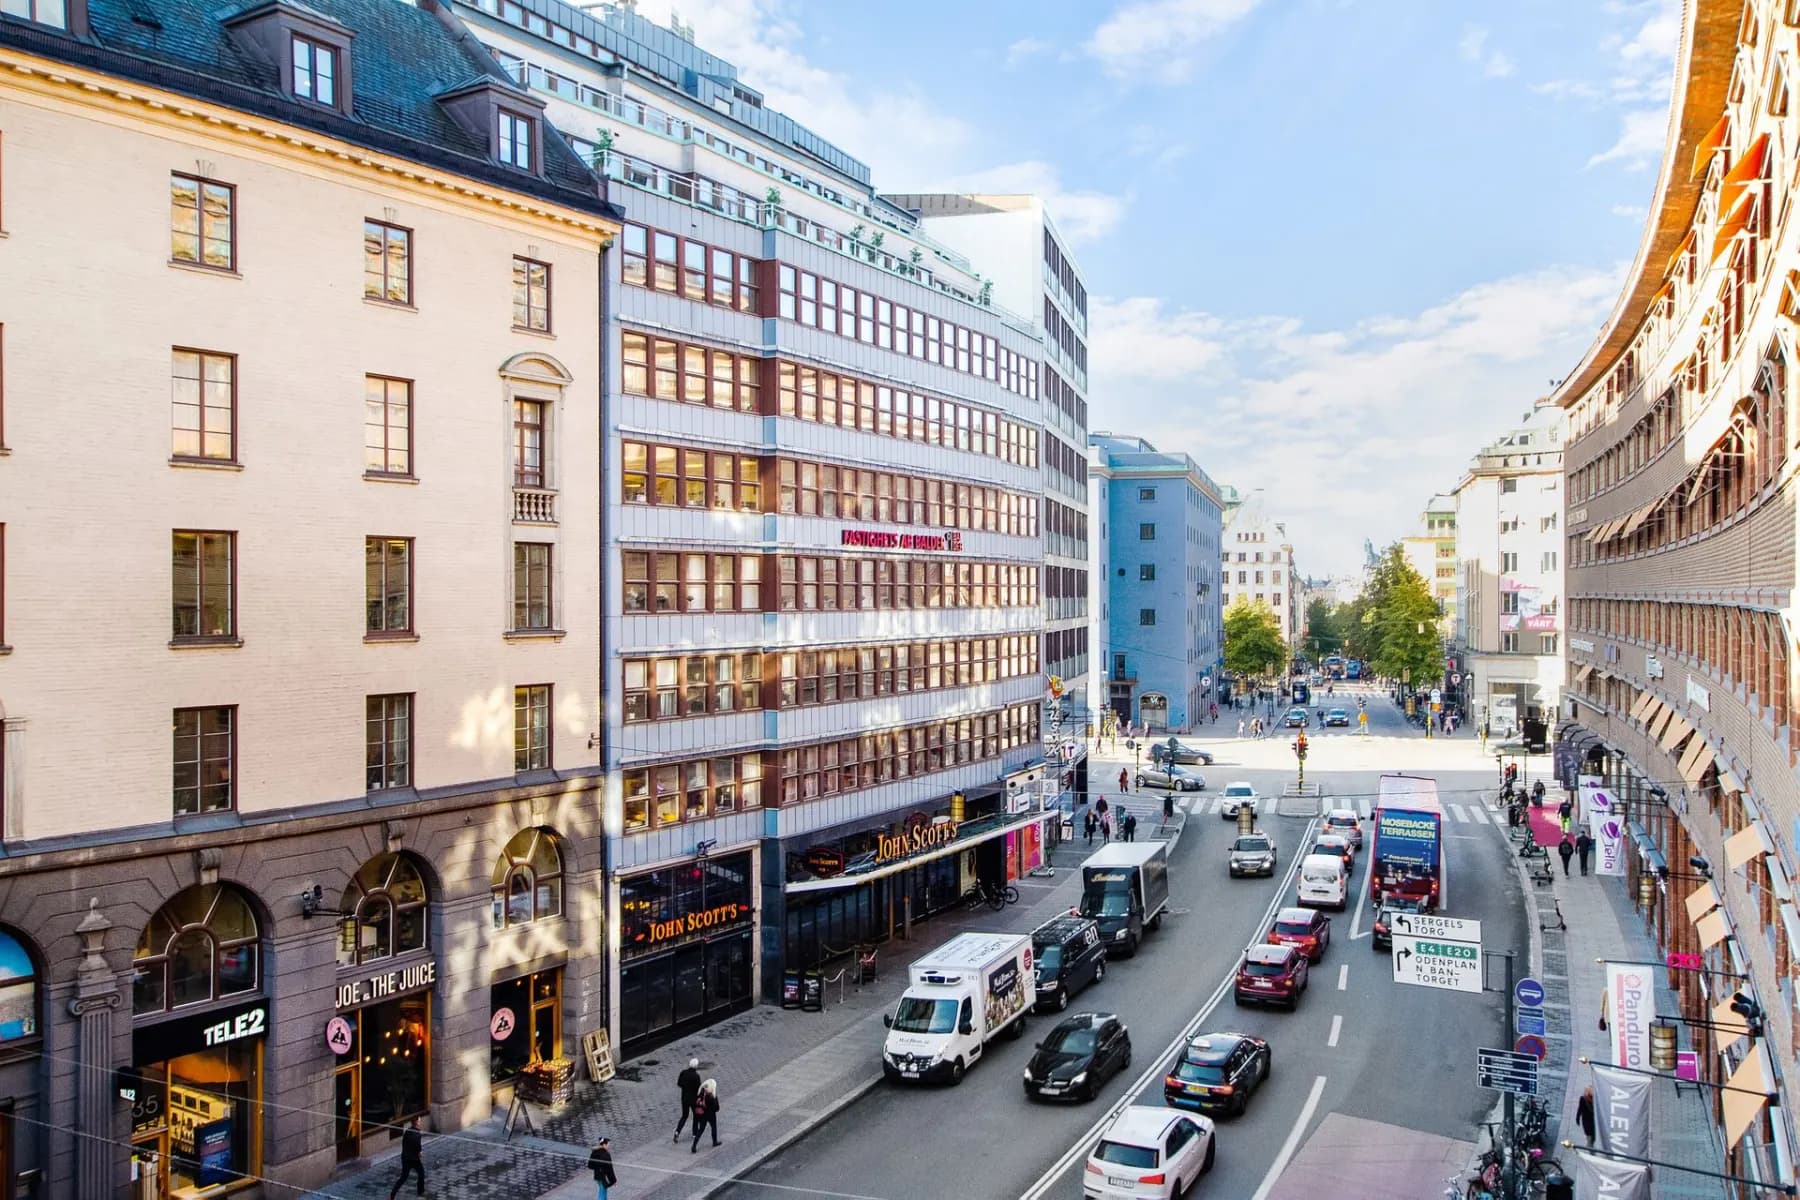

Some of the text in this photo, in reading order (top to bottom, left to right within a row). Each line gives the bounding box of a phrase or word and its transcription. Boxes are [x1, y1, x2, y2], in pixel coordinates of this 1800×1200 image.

[842, 529, 898, 548] FASTIGHETS
[1381, 817, 1436, 830] MOSEBACKE
[1381, 826, 1435, 839] TERRASSEN
[876, 832, 910, 863] JOHN
[1604, 842, 1616, 869] Telia
[649, 903, 737, 943] JOHN SCOTT'S
[1414, 917, 1463, 929] SERGELS
[1414, 926, 1445, 936] TORG
[1421, 944, 1471, 957] E4 E20
[1415, 955, 1476, 970] ODENPLAN
[1416, 965, 1460, 976] N BAN-
[336, 981, 360, 1008] JOE
[370, 972, 396, 998] THE
[399, 961, 436, 990] JUICE
[1416, 973, 1460, 986] TORGET
[203, 1008, 265, 1046] TELE2
[1625, 989, 1644, 1066] Panduro
[120, 1088, 136, 1102] TELE2
[132, 1094, 158, 1118] 35
